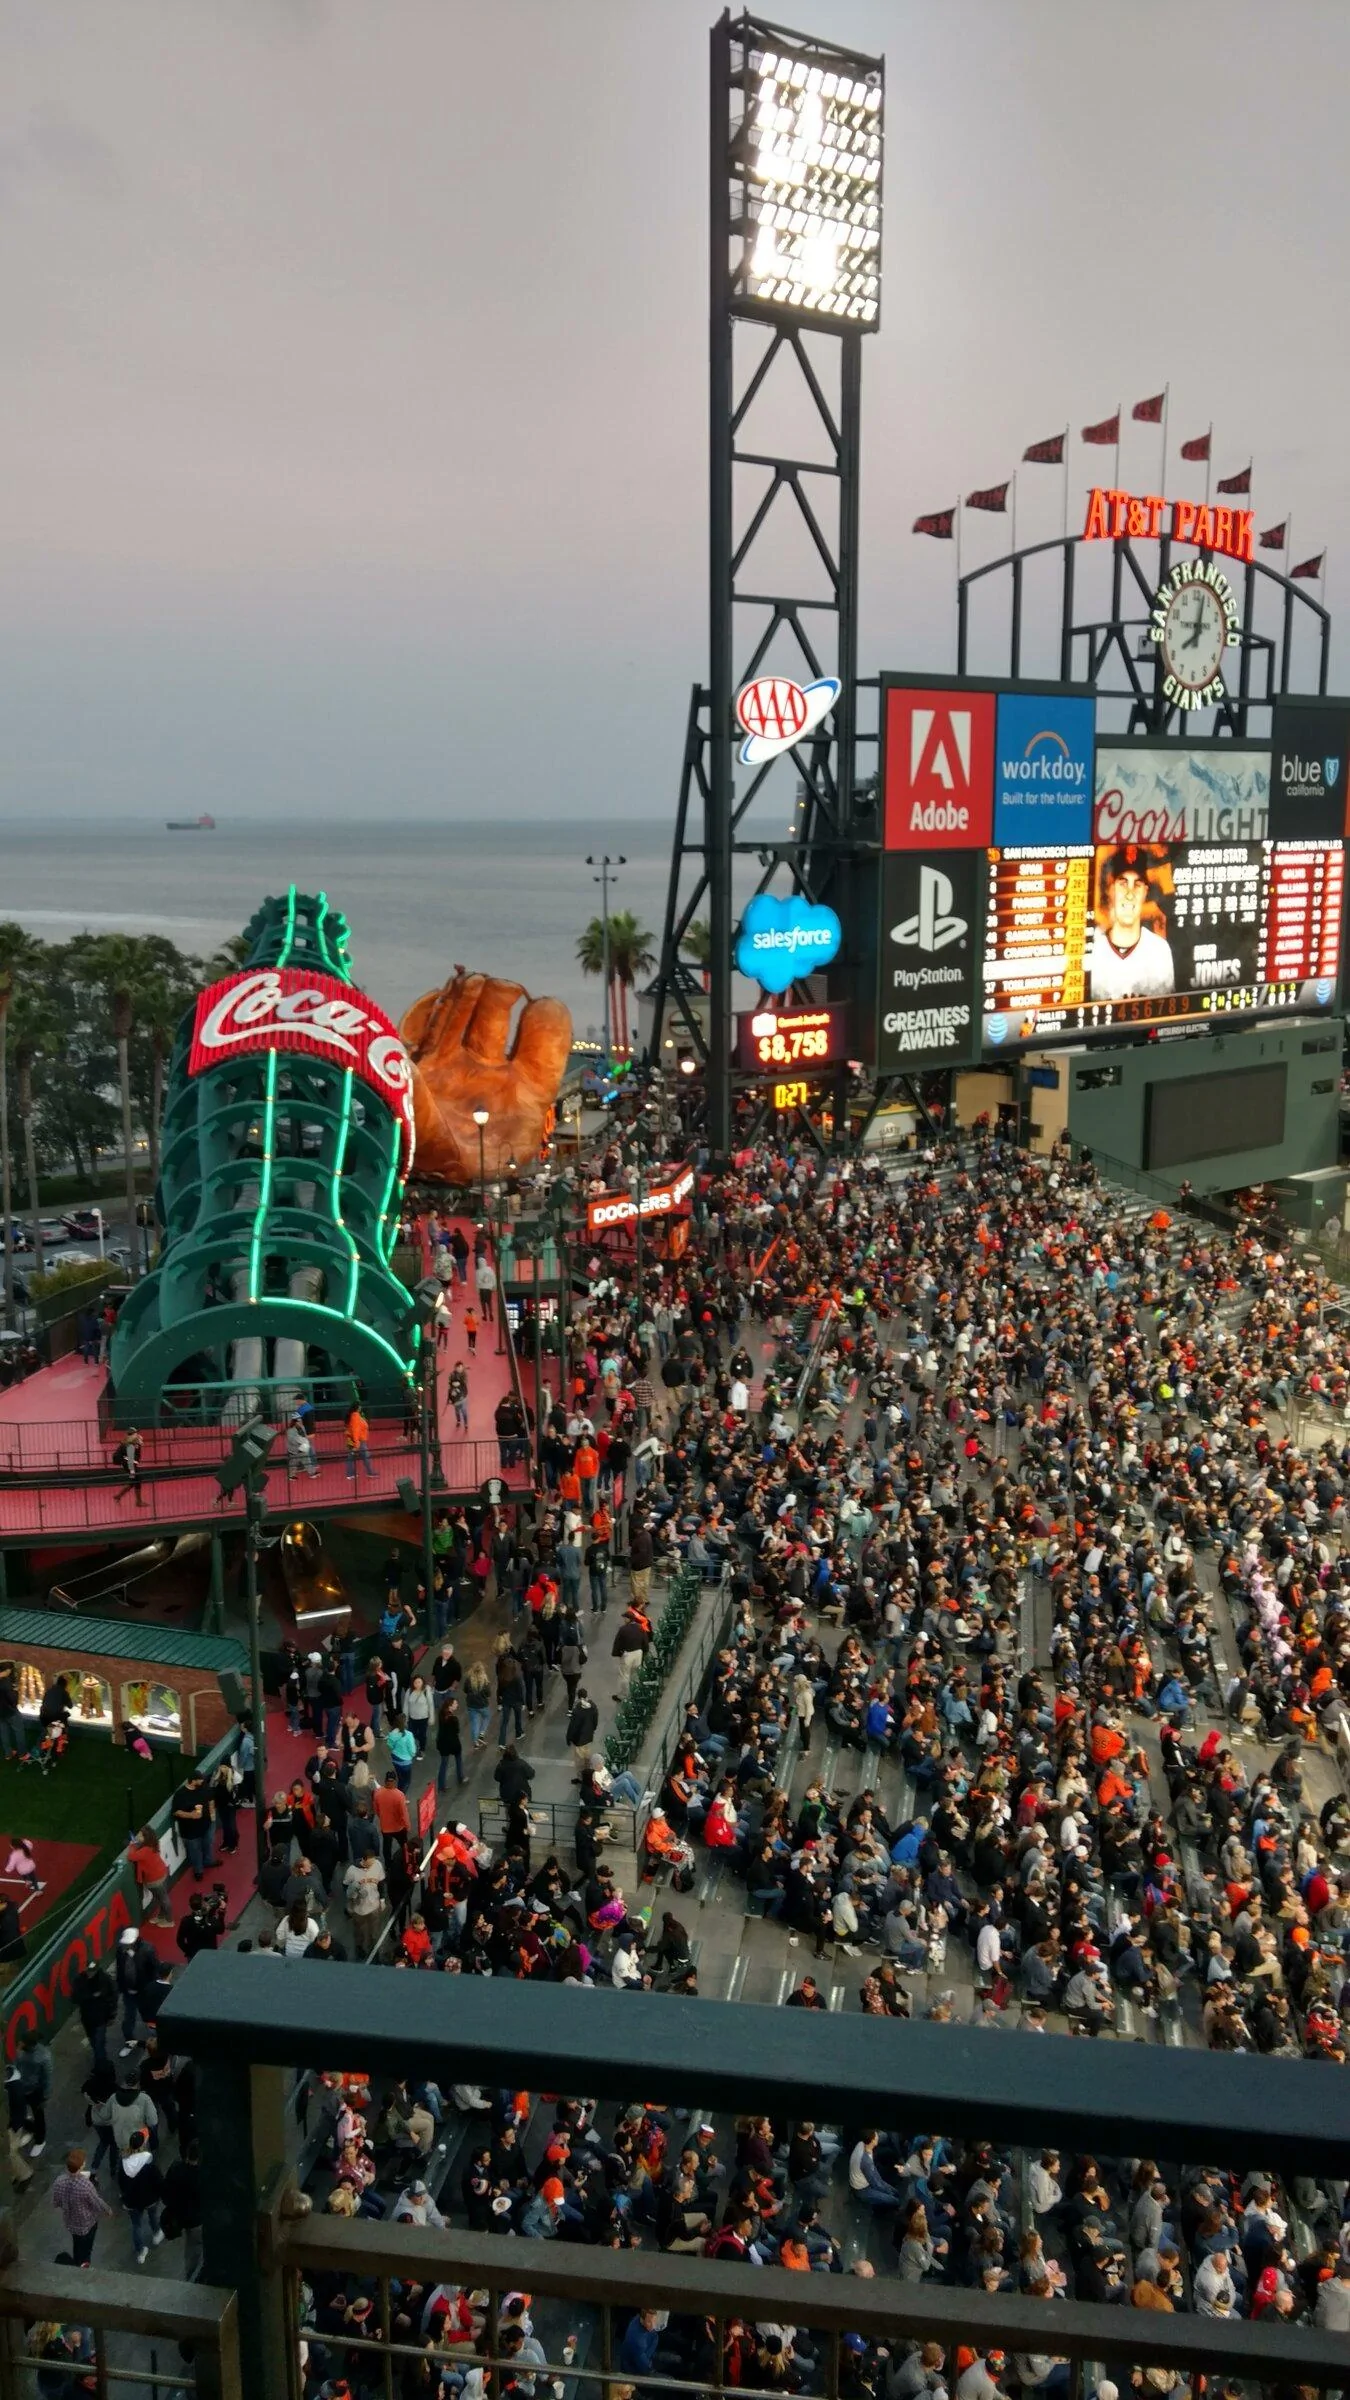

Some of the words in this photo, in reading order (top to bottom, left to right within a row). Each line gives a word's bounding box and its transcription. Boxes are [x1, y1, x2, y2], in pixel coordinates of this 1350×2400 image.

[1083, 487, 1167, 540] AT&T
[1174, 500, 1256, 562] PARK
[1151, 584, 1175, 642] SAN
[1170, 559, 1240, 647] FRANCISCO
[1162, 674, 1225, 710] GIANTS
[744, 681, 801, 738] AAA
[1002, 755, 1084, 785] workday
[1281, 754, 1321, 782] blue
[1002, 792, 1023, 805] Built
[1025, 792, 1038, 804] for
[1040, 792, 1055, 804] the
[1287, 784, 1325, 796] california
[910, 800, 969, 831] Adobe
[1094, 789, 1188, 843] Coors
[1193, 808, 1268, 842] LIGHT
[1003, 847, 1020, 860] SAN
[1188, 849, 1222, 865] SEASON
[1223, 848, 1248, 863] STATS
[990, 865, 997, 878] 2
[753, 926, 832, 953] salesforce
[894, 966, 962, 991] PlayStation
[1190, 959, 1241, 988] JONES
[1117, 1004, 1126, 1021] 4
[1132, 1003, 1139, 1018] 5
[1144, 1002, 1152, 1018] 6
[1157, 1000, 1165, 1015] 7
[1168, 998, 1176, 1014] 8
[1182, 996, 1190, 1012] 9
[1288, 990, 1296, 1004] 2
[884, 1005, 970, 1033] GREATNESS
[200, 972, 416, 1126] Coca-C
[759, 1030, 828, 1064] $8,758
[775, 1082, 807, 1109] 0:27
[593, 1193, 671, 1224] DOCKERS
[2, 1890, 131, 2061] OYOTA
